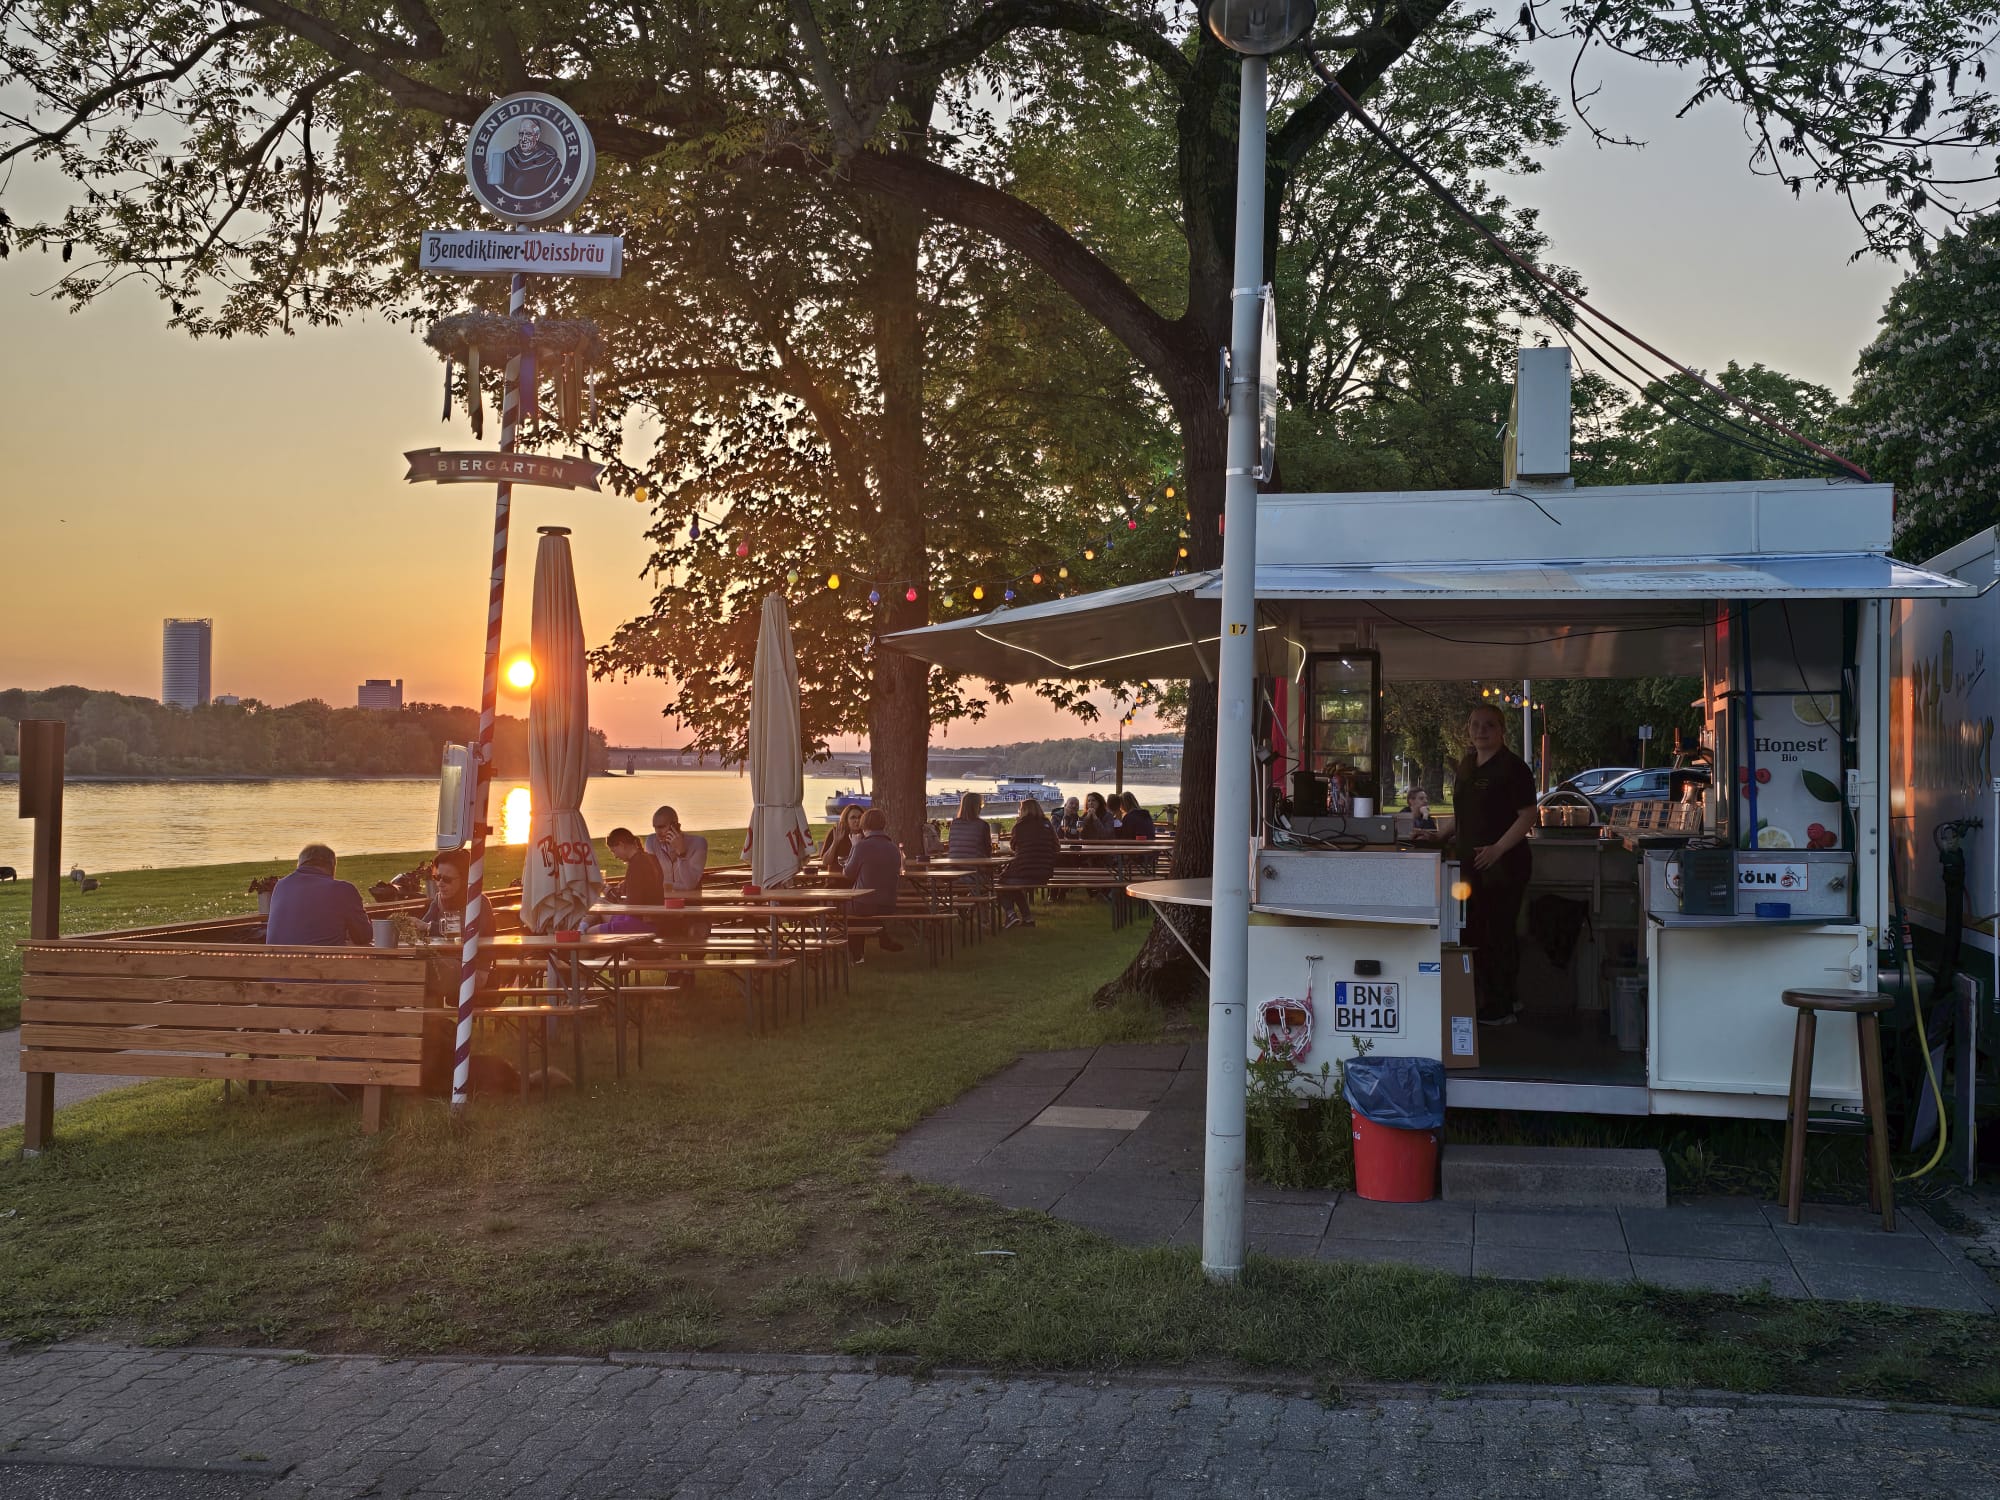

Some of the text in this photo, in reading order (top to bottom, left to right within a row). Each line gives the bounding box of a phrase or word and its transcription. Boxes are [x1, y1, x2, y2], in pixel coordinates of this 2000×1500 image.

[475, 101, 579, 158] BENEDIKTINER
[438, 459, 563, 480] BIERGARTEN
[1231, 623, 1247, 635] 17
[1754, 737, 1825, 752] Honest
[1781, 753, 1798, 762] Bio
[1353, 985, 1381, 1006] BN
[1337, 1007, 1397, 1029] BH 10
